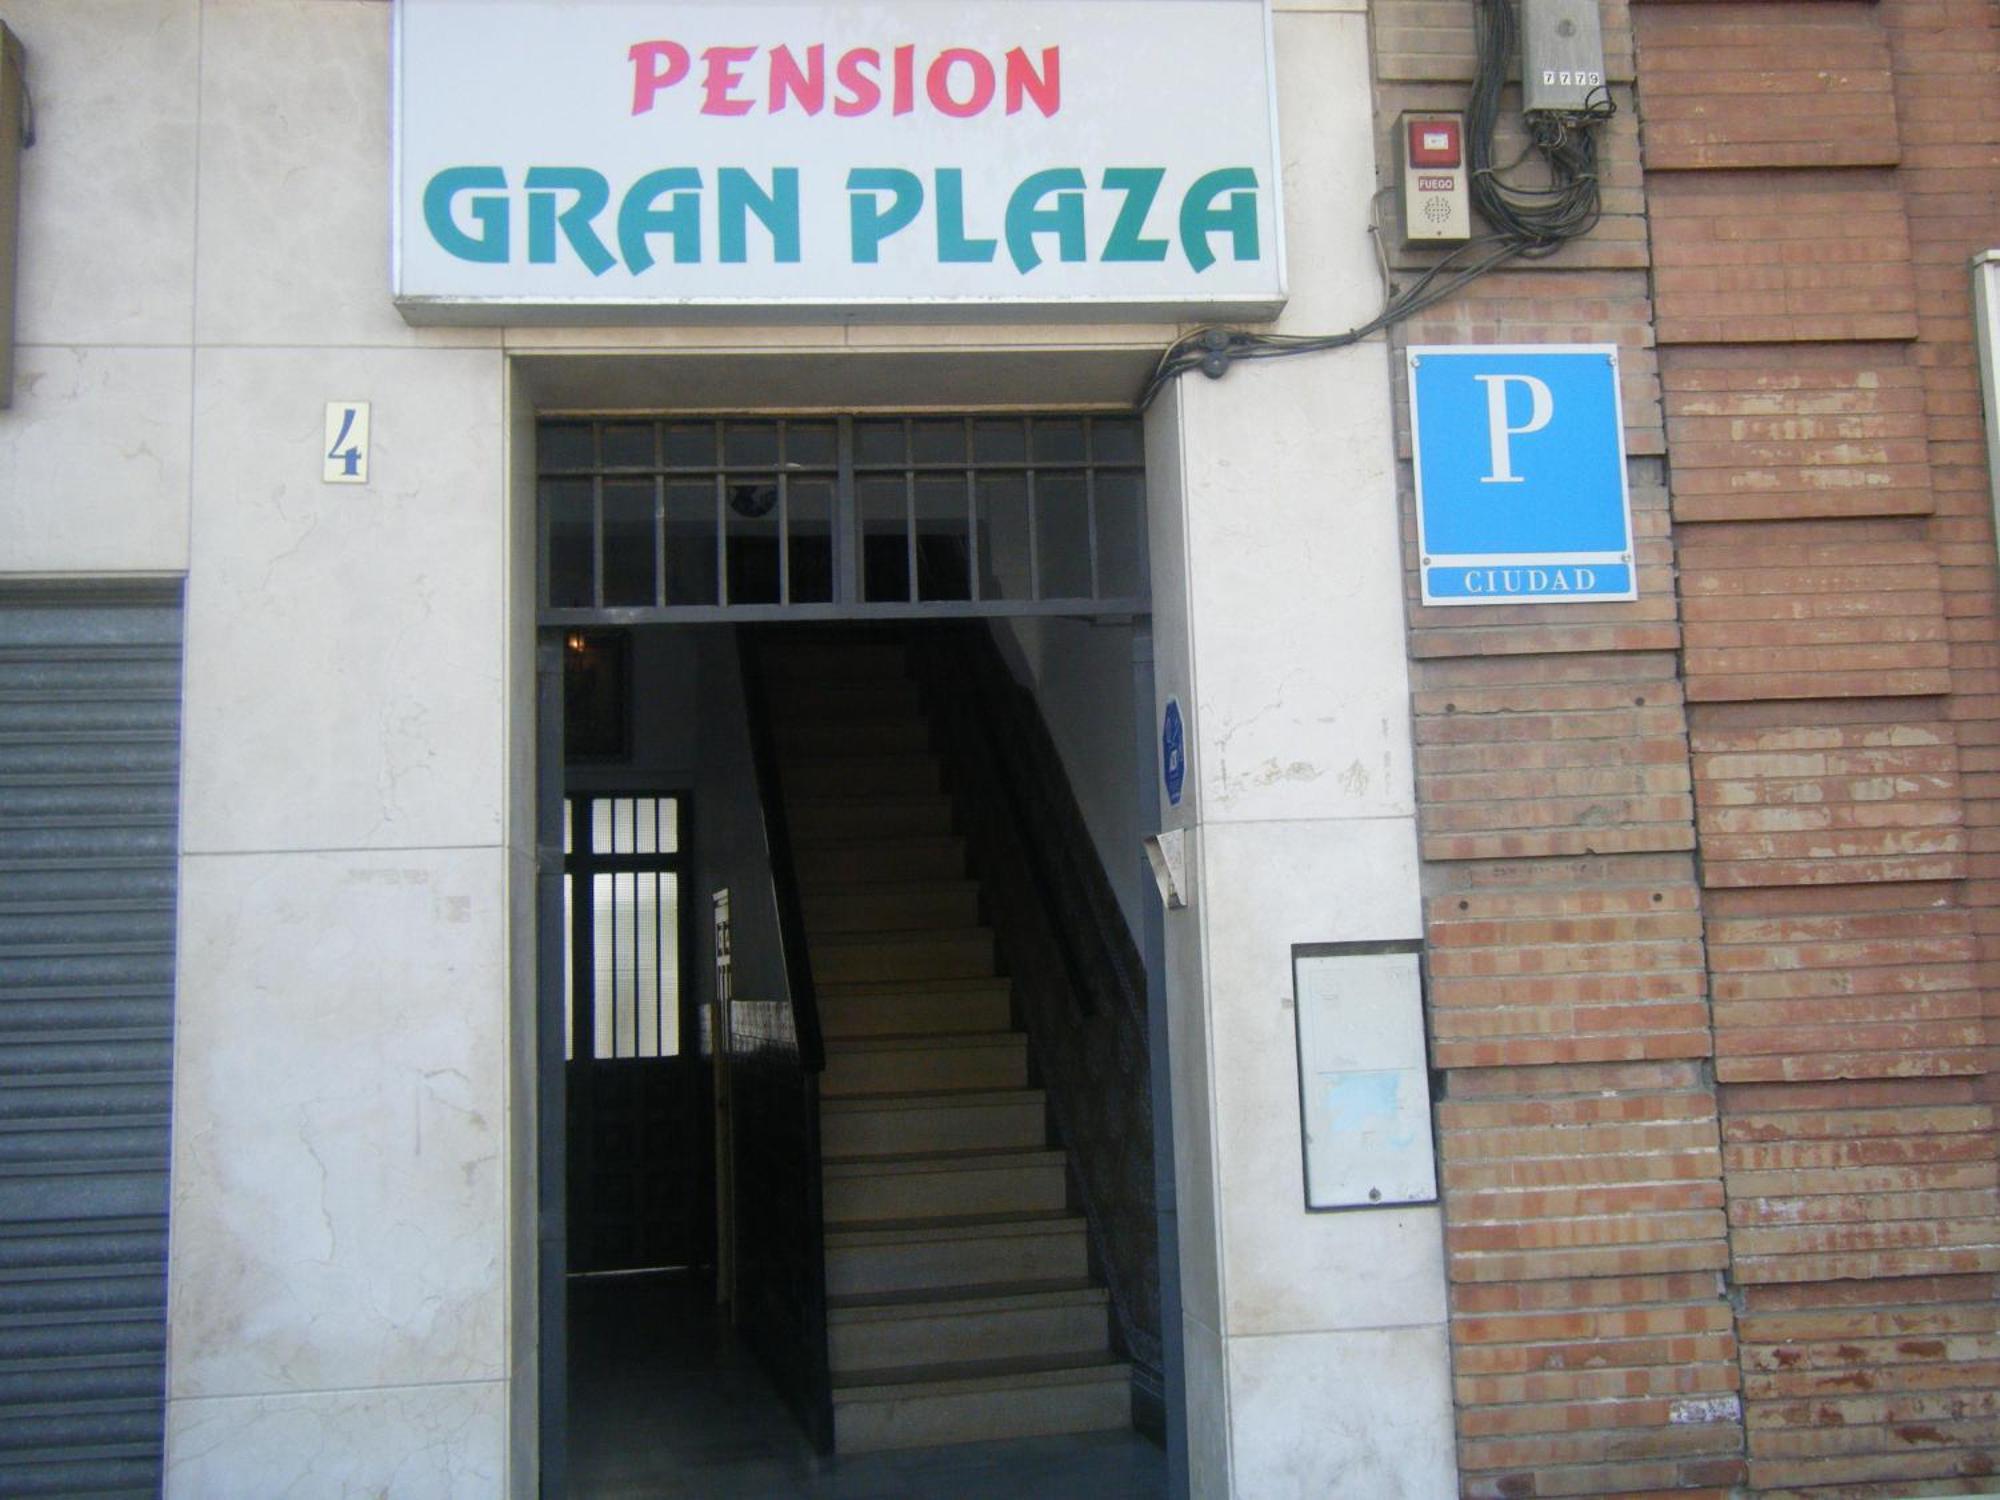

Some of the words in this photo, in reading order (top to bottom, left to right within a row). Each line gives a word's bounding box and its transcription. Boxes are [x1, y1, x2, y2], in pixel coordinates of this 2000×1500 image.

[628, 41, 1060, 118] PENSION
[1419, 178, 1453, 190] FUEGO
[423, 167, 801, 276] GRAN
[846, 167, 1260, 275] PLAZA
[328, 409, 362, 476] 4
[1474, 374, 1554, 482] P
[1465, 569, 1596, 592] CIUDAD
